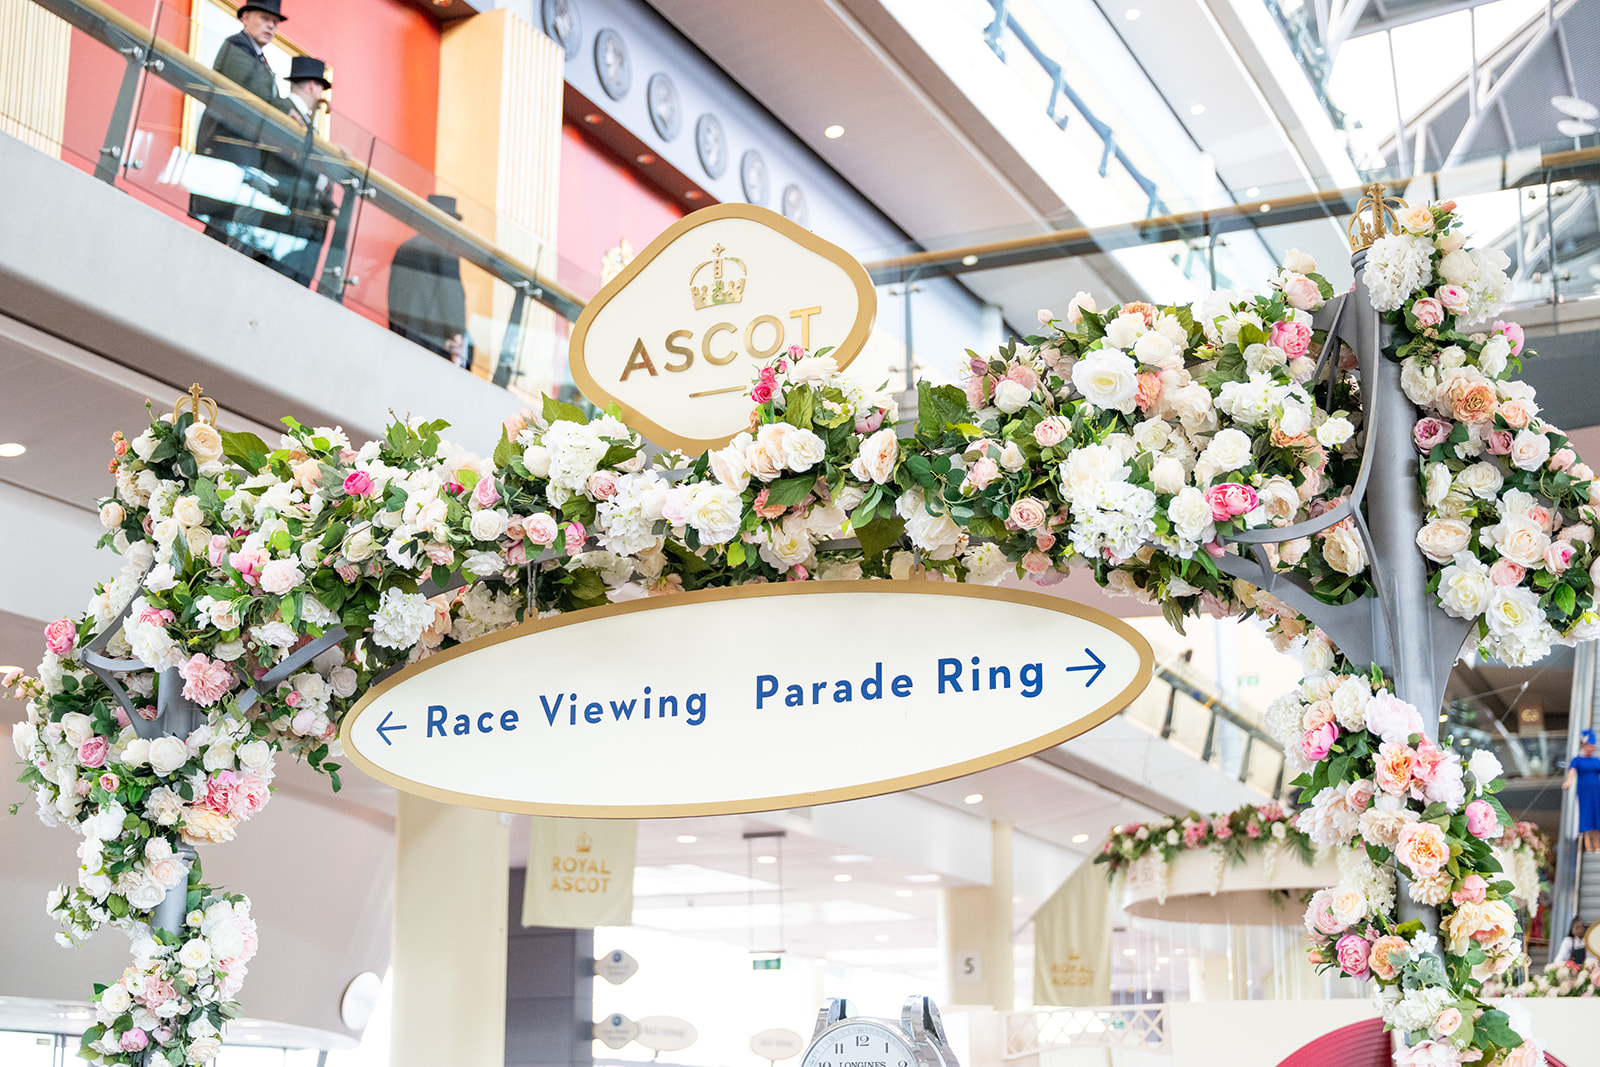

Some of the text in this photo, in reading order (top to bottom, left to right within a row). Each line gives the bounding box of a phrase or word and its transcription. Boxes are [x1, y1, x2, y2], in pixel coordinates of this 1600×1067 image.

[619, 305, 822, 382] ASCOT
[756, 655, 1044, 710] Parade Ring
[426, 685, 707, 738] Race Viewing
[552, 856, 611, 875] ROYAL
[550, 876, 611, 893] ASCOT
[963, 956, 975, 975] 5
[834, 1043, 844, 1054] 11
[855, 1035, 870, 1047] 12
